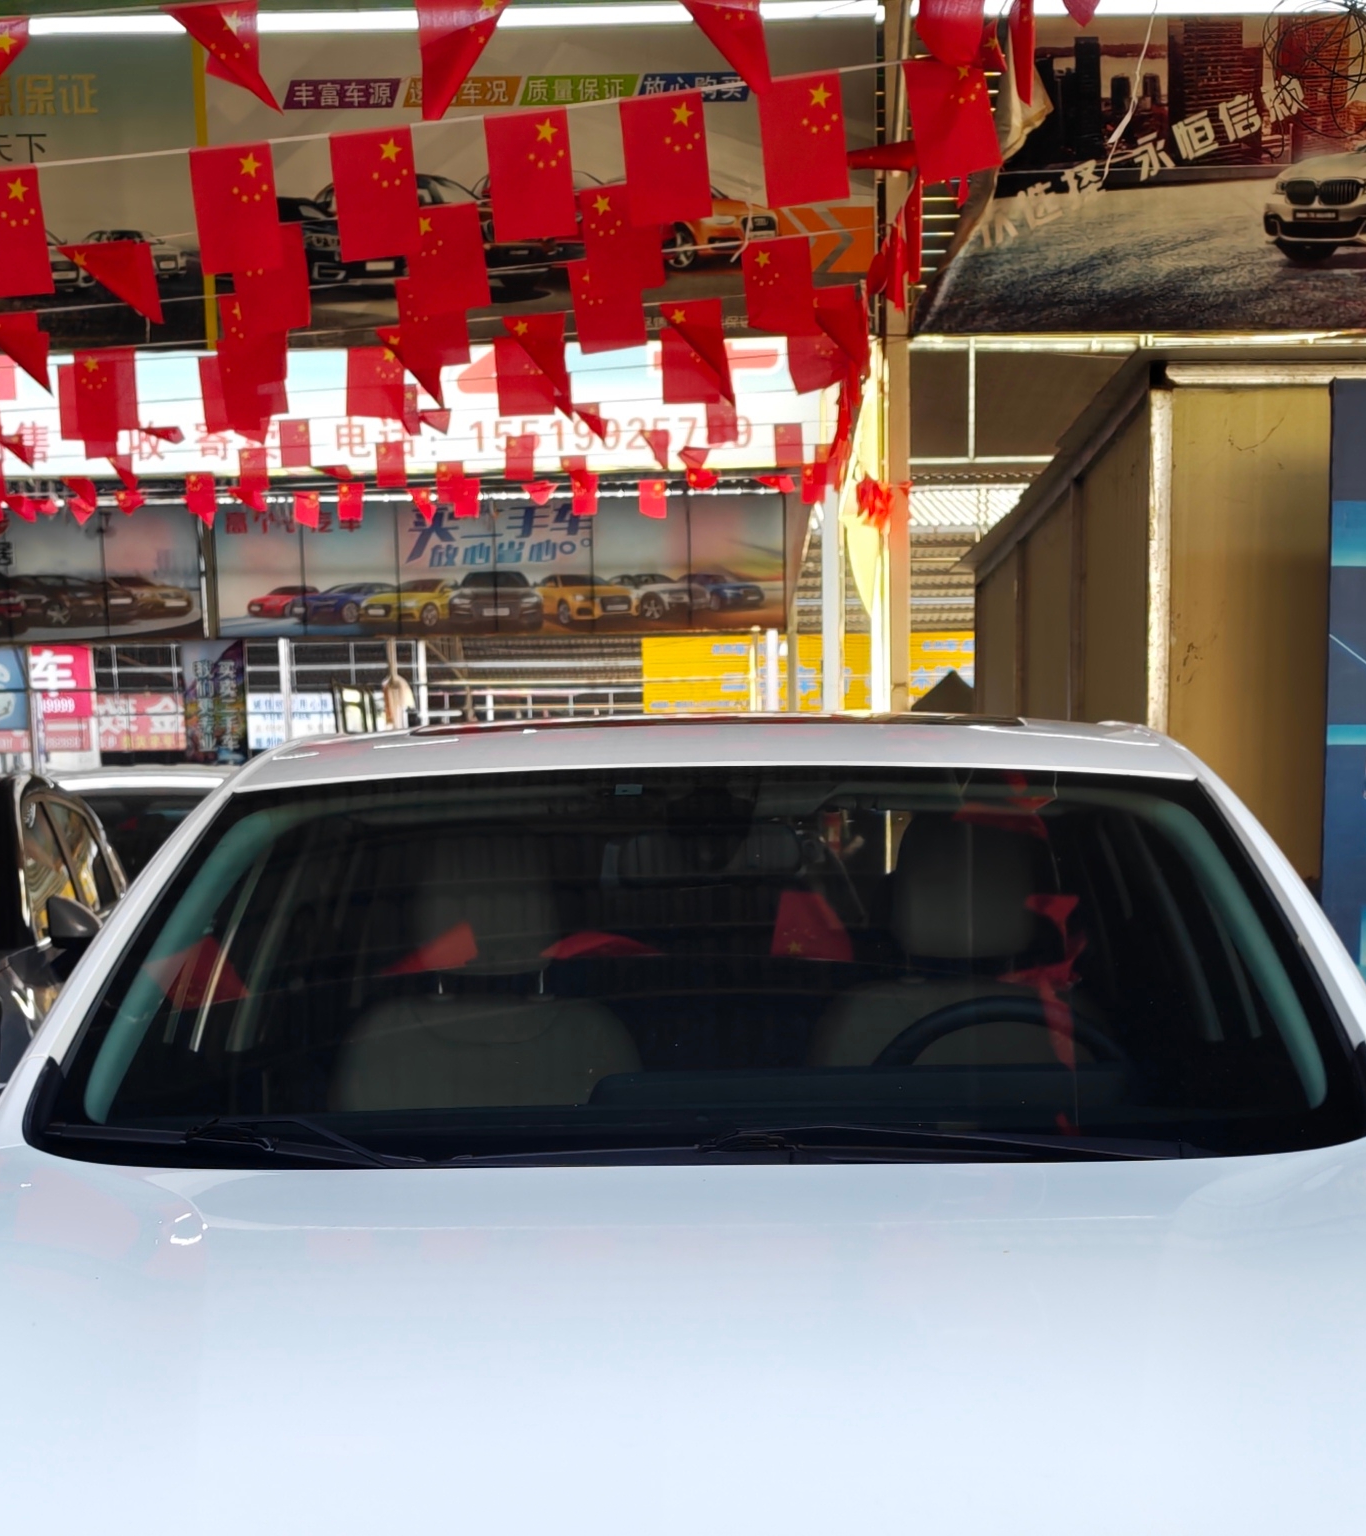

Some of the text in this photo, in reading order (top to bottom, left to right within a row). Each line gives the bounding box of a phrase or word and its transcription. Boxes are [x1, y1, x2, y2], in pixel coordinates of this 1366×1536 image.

[293, 81, 392, 106] 丰富车源
[527, 78, 625, 101] 质量保证
[469, 416, 753, 453] 1551992579
